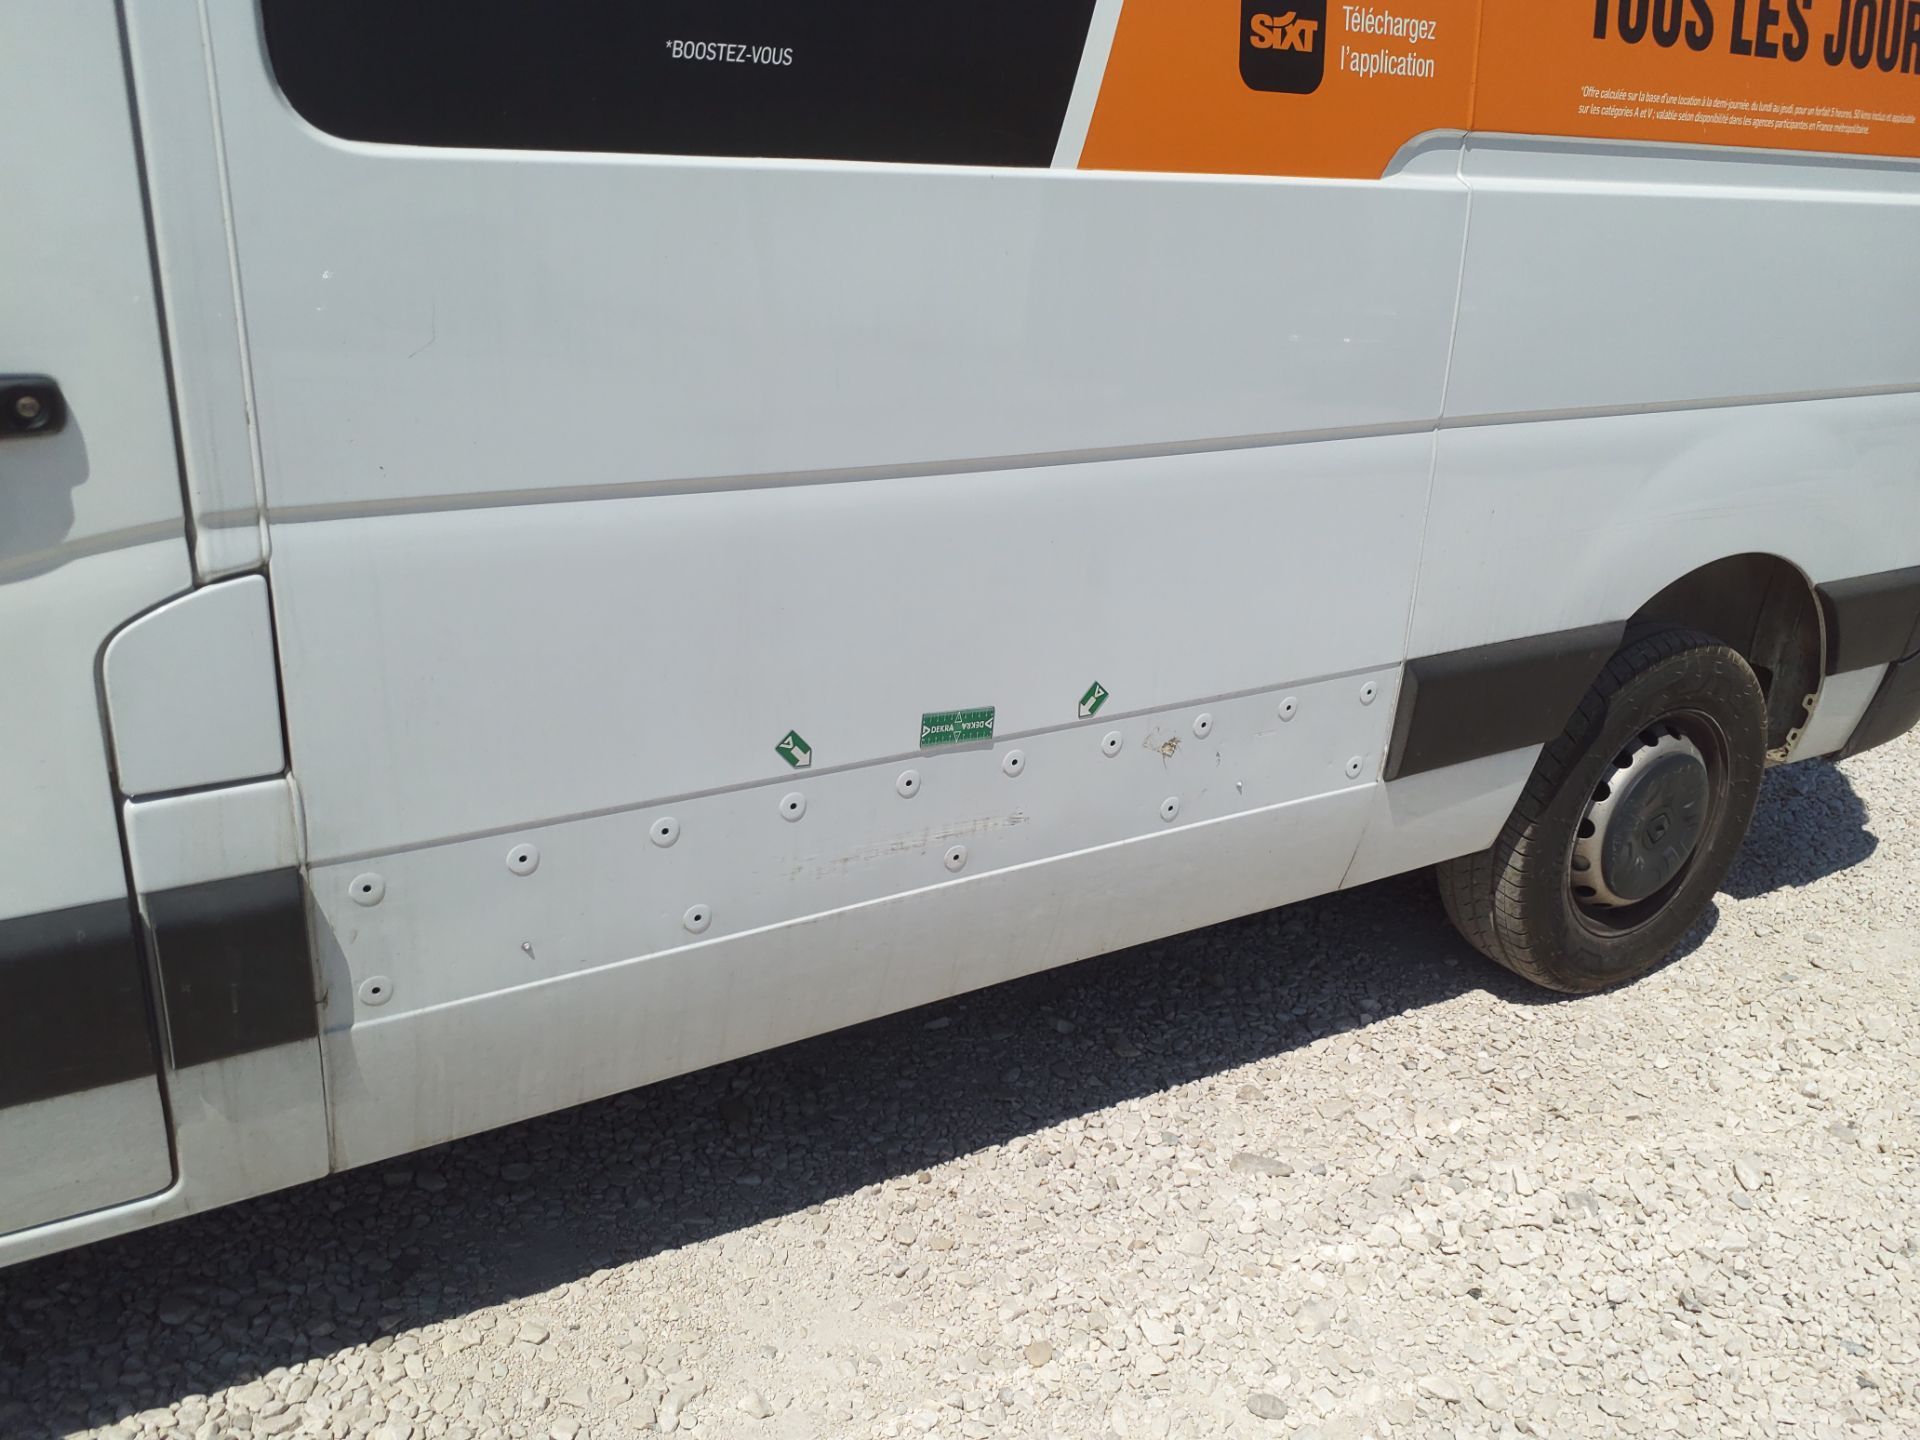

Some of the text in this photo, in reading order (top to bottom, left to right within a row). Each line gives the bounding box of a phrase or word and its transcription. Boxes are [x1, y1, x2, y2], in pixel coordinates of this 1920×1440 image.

[1342, 5, 1437, 43] Téléchargez
[1730, 0, 1809, 62] LES
[1340, 45, 1434, 77] l'application
[1600, 88, 1627, 100] calculée
[1628, 92, 1638, 102] sur
[1639, 91, 1646, 102] la
[1646, 92, 1660, 103] base
[1678, 94, 1701, 106] location
[1759, 102, 1773, 112] lundi
[1578, 104, 1590, 114] sur
[1590, 104, 1600, 114] les
[1601, 105, 1634, 118] catégories
[1634, 107, 1640, 117] A
[1640, 109, 1647, 118] et
[1656, 109, 1678, 120] valable
[1678, 110, 1694, 122] selon
[1729, 114, 1742, 124] dans
[1743, 114, 1752, 126] les
[1752, 118, 1774, 129] agences
[1816, 121, 1833, 132] France
[931, 724, 954, 734] DEKRA
[961, 721, 985, 730] DEKRA
